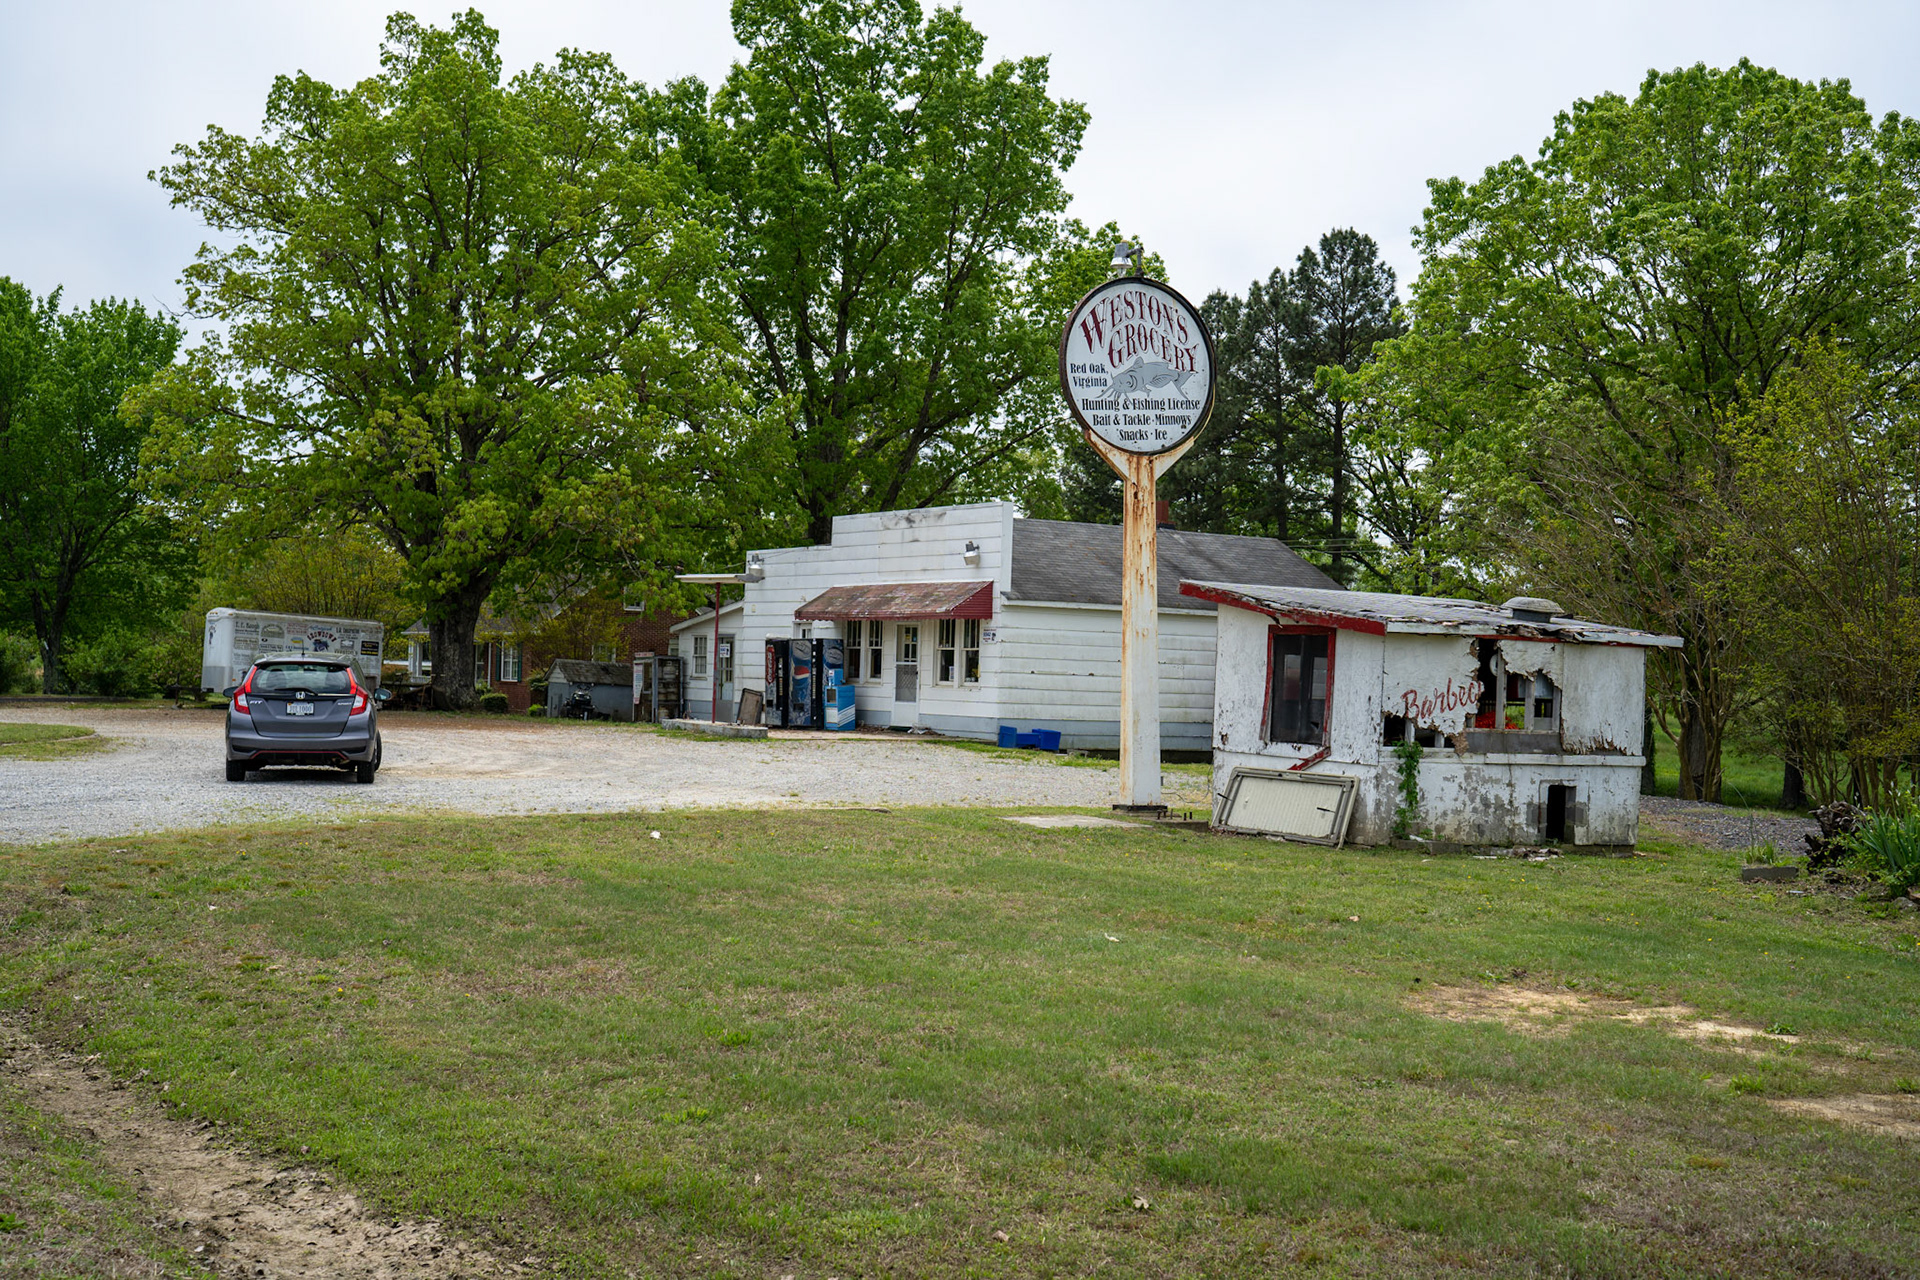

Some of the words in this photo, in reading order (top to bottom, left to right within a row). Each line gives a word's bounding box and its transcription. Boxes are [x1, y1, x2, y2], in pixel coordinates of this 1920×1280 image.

[1079, 290, 1189, 354] WESTON'S
[1108, 323, 1199, 373] GROCERY
[1070, 363, 1088, 373] Red
[1090, 363, 1109, 374] Oak,
[1073, 376, 1108, 388] Virginia
[1082, 399, 1119, 411] Hunting
[1122, 400, 1130, 410] &
[1133, 399, 1166, 411] Fishing
[1168, 399, 1200, 411] License
[1093, 414, 1111, 425] Bait
[1113, 414, 1121, 425] &
[1123, 414, 1150, 425] Tackle
[1155, 414, 1192, 426] Minnows
[1119, 429, 1148, 441] Snacks
[1155, 430, 1168, 440] Ice
